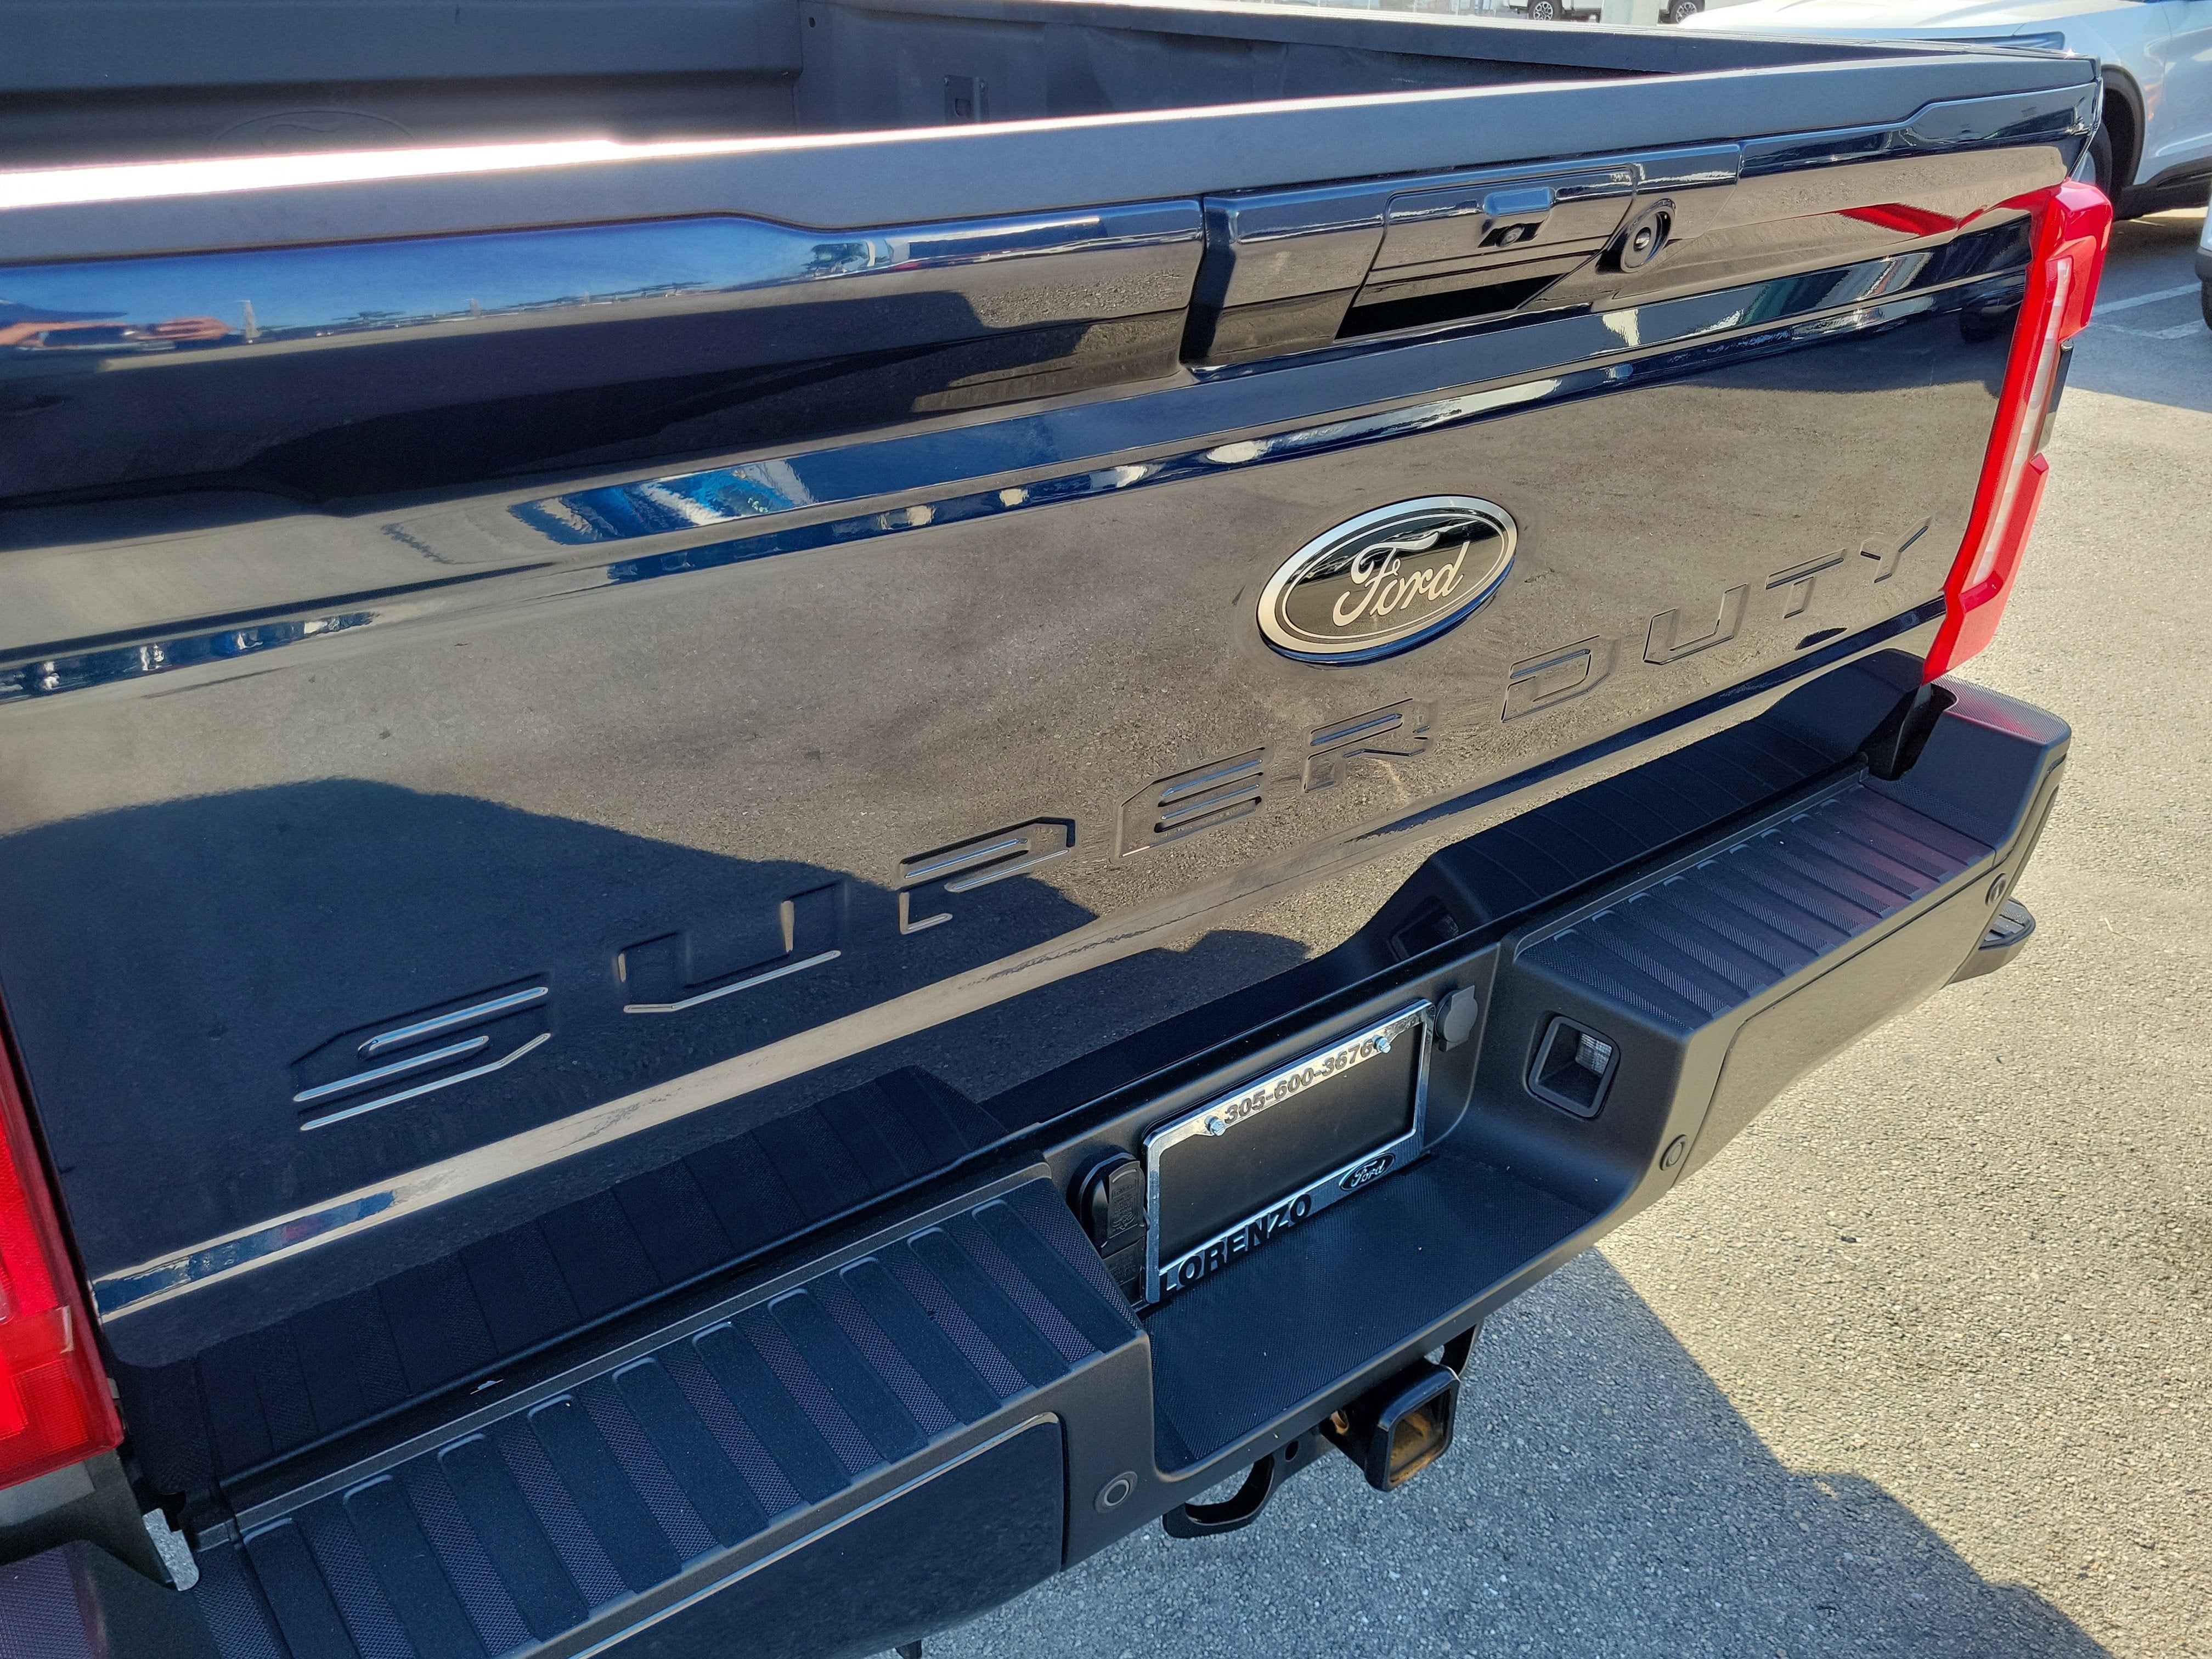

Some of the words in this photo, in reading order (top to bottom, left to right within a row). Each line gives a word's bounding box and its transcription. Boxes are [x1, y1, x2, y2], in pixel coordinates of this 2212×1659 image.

[1331, 530, 1470, 627] Ford
[291, 697, 1436, 1131] SUPER
[1500, 516, 1931, 724] DUTY
[1224, 1039, 1375, 1124] 305-600-3676
[1159, 1194, 1312, 1300] LORENZO
[1350, 1159, 1386, 1188] Ford
